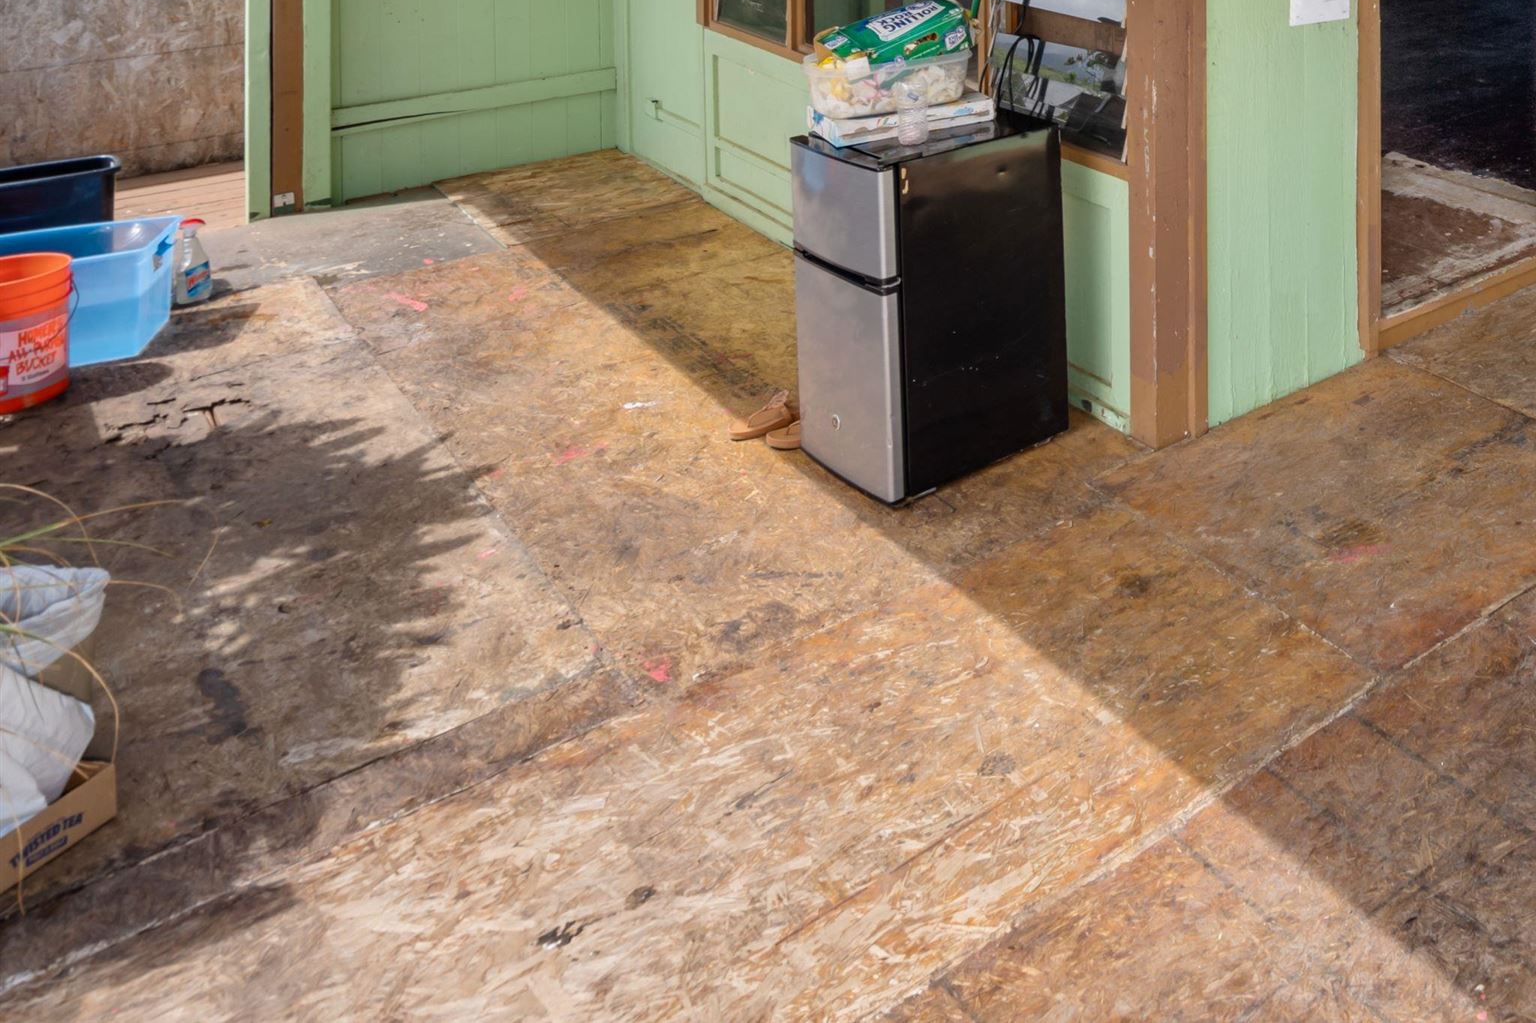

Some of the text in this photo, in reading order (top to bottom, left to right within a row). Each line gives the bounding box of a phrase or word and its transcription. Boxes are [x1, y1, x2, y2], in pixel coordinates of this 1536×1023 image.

[877, 10, 913, 26] ROCK
[882, 4, 938, 33] ROLLING
[16, 350, 57, 376] BUCKET
[9, 823, 61, 868] TWISTED
[63, 812, 84, 830] TEA
